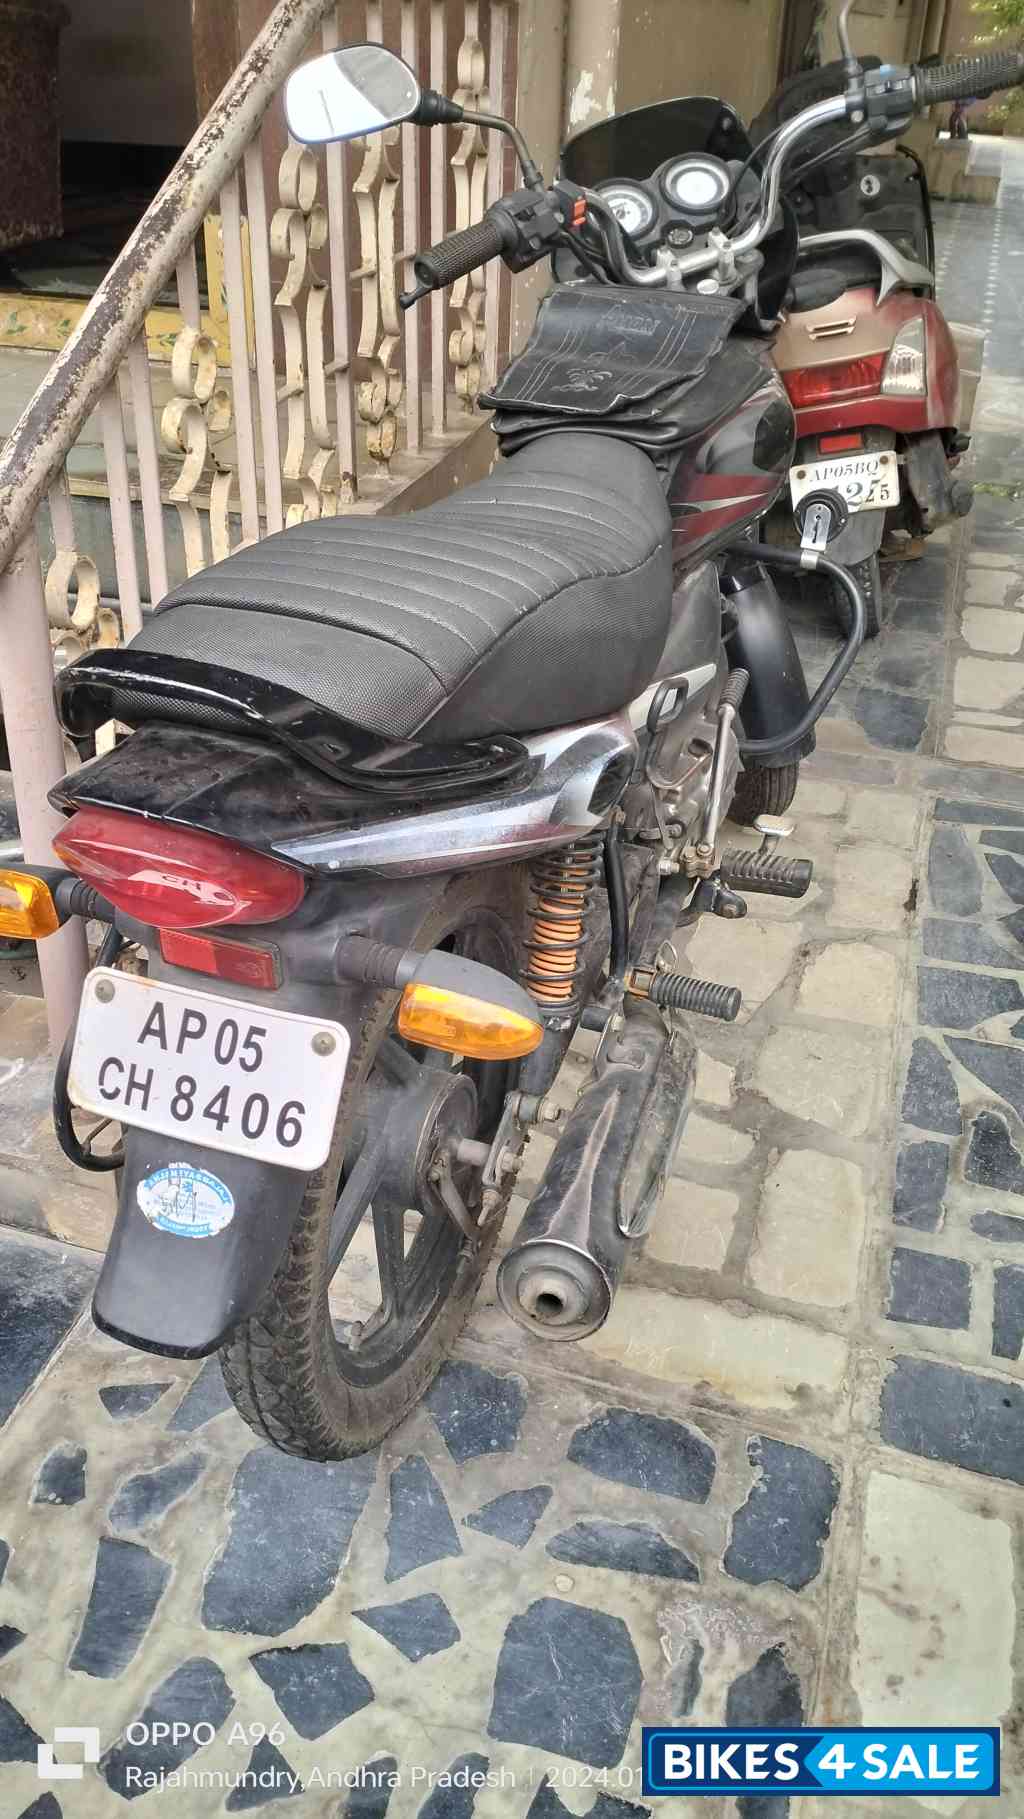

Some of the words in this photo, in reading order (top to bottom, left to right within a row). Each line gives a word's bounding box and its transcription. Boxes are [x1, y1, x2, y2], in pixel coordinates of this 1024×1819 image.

[137, 1001, 268, 1073] AP05
[98, 1056, 154, 1111] CH
[170, 1075, 306, 1148] 8406
